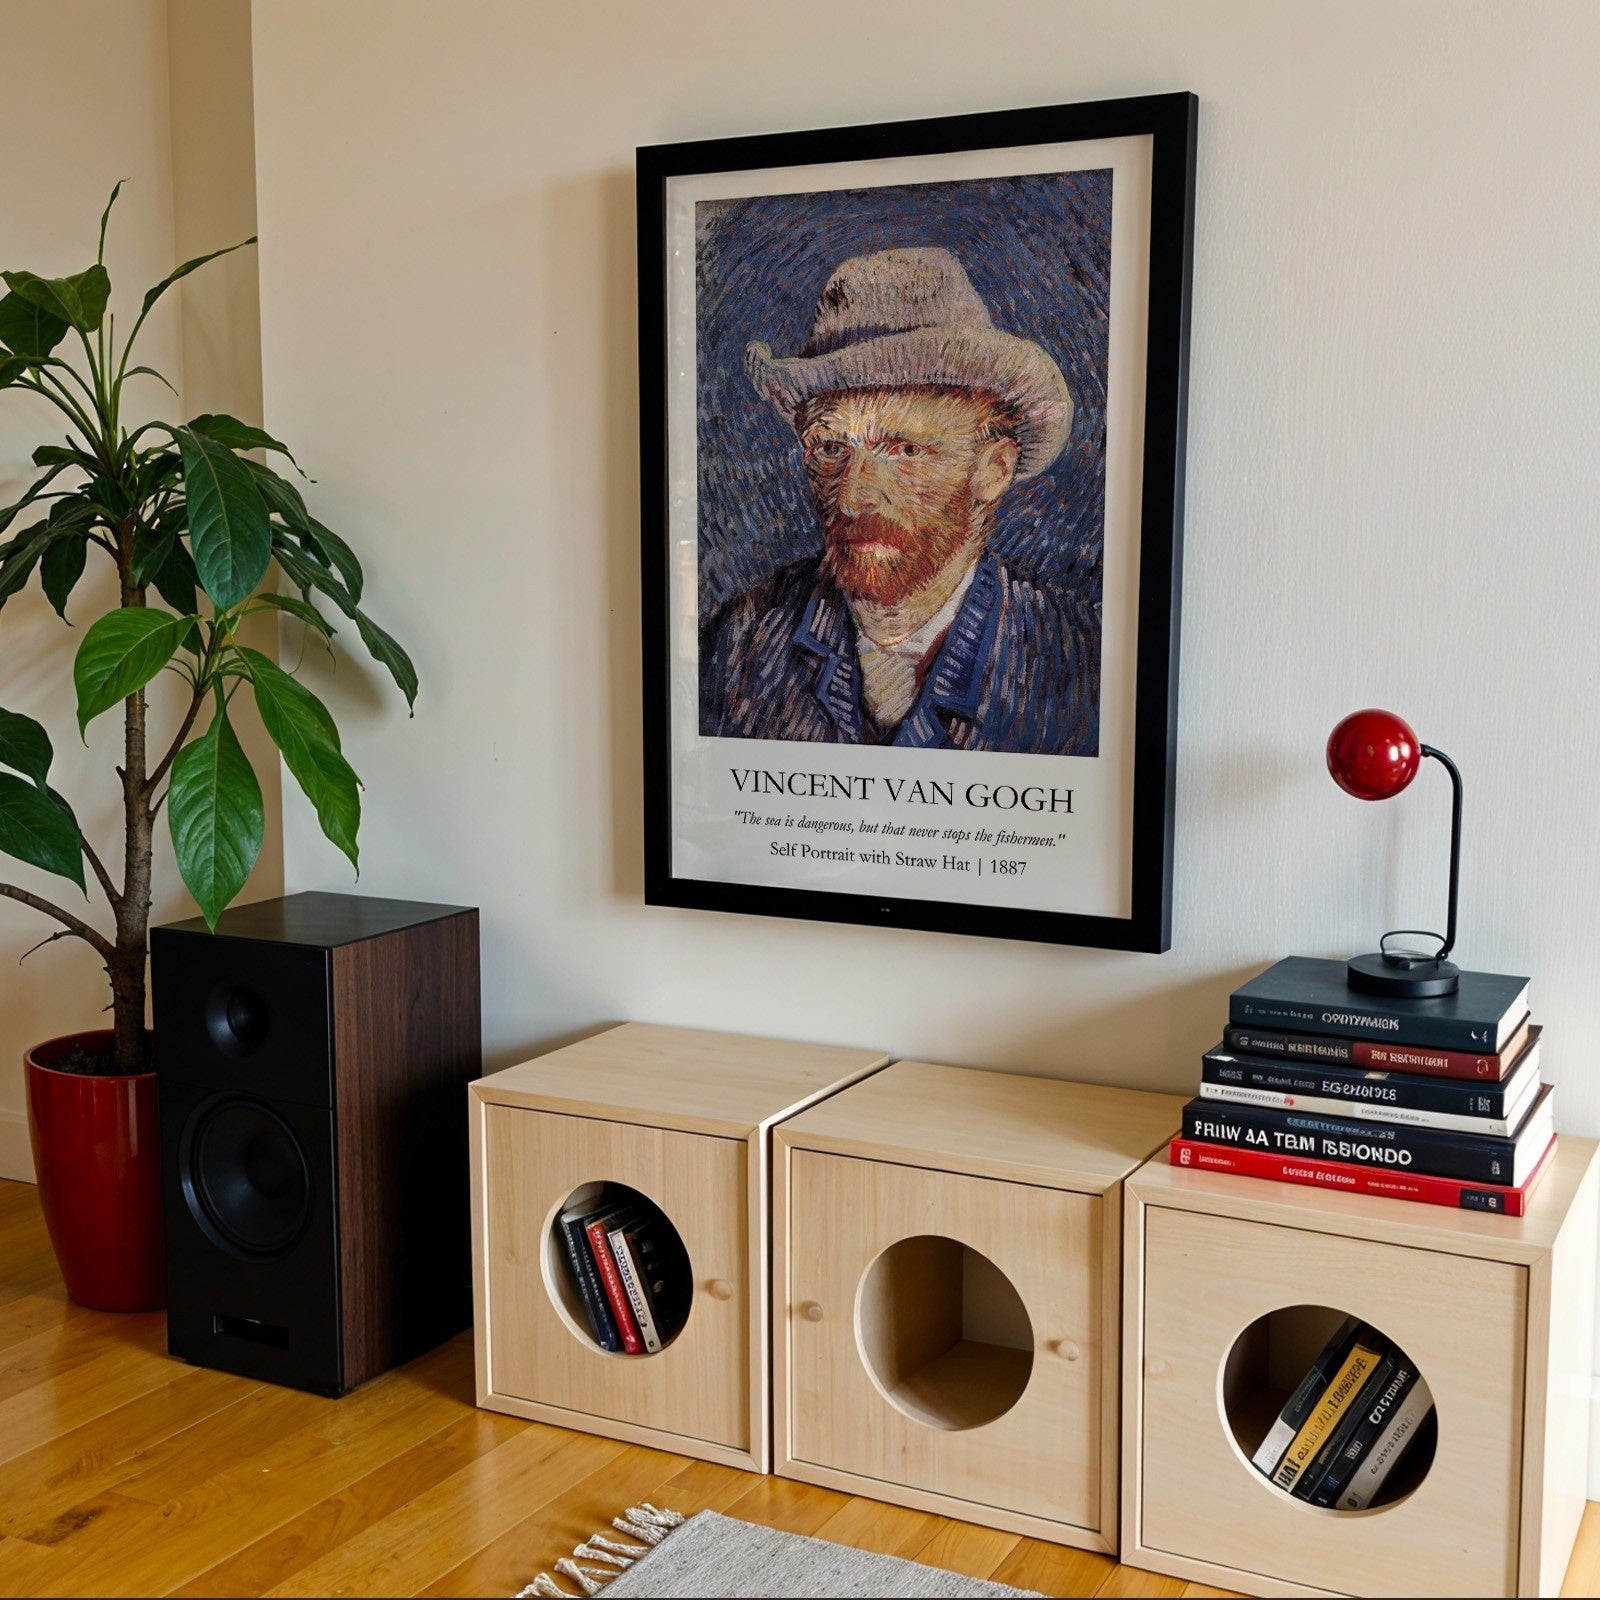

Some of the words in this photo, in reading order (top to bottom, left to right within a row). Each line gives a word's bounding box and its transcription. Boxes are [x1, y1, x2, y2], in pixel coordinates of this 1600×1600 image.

[729, 768, 875, 801] VINCENT
[883, 778, 955, 807] VAN
[965, 783, 1075, 814] GOGH
[734, 810, 762, 826] "The
[764, 816, 782, 827] sea
[784, 815, 795, 828] is
[797, 815, 854, 834] dangerous,
[859, 820, 880, 834] but
[881, 821, 907, 836] that
[908, 827, 940, 839] never
[941, 828, 972, 845] stops
[974, 828, 994, 843] the
[991, 829, 1067, 847] fishermen."
[769, 841, 799, 858] Self
[800, 843, 856, 863] Portrait
[858, 849, 891, 865] with
[895, 851, 938, 869] Straw
[942, 854, 971, 872] Hat
[990, 858, 1028, 876] 1887
